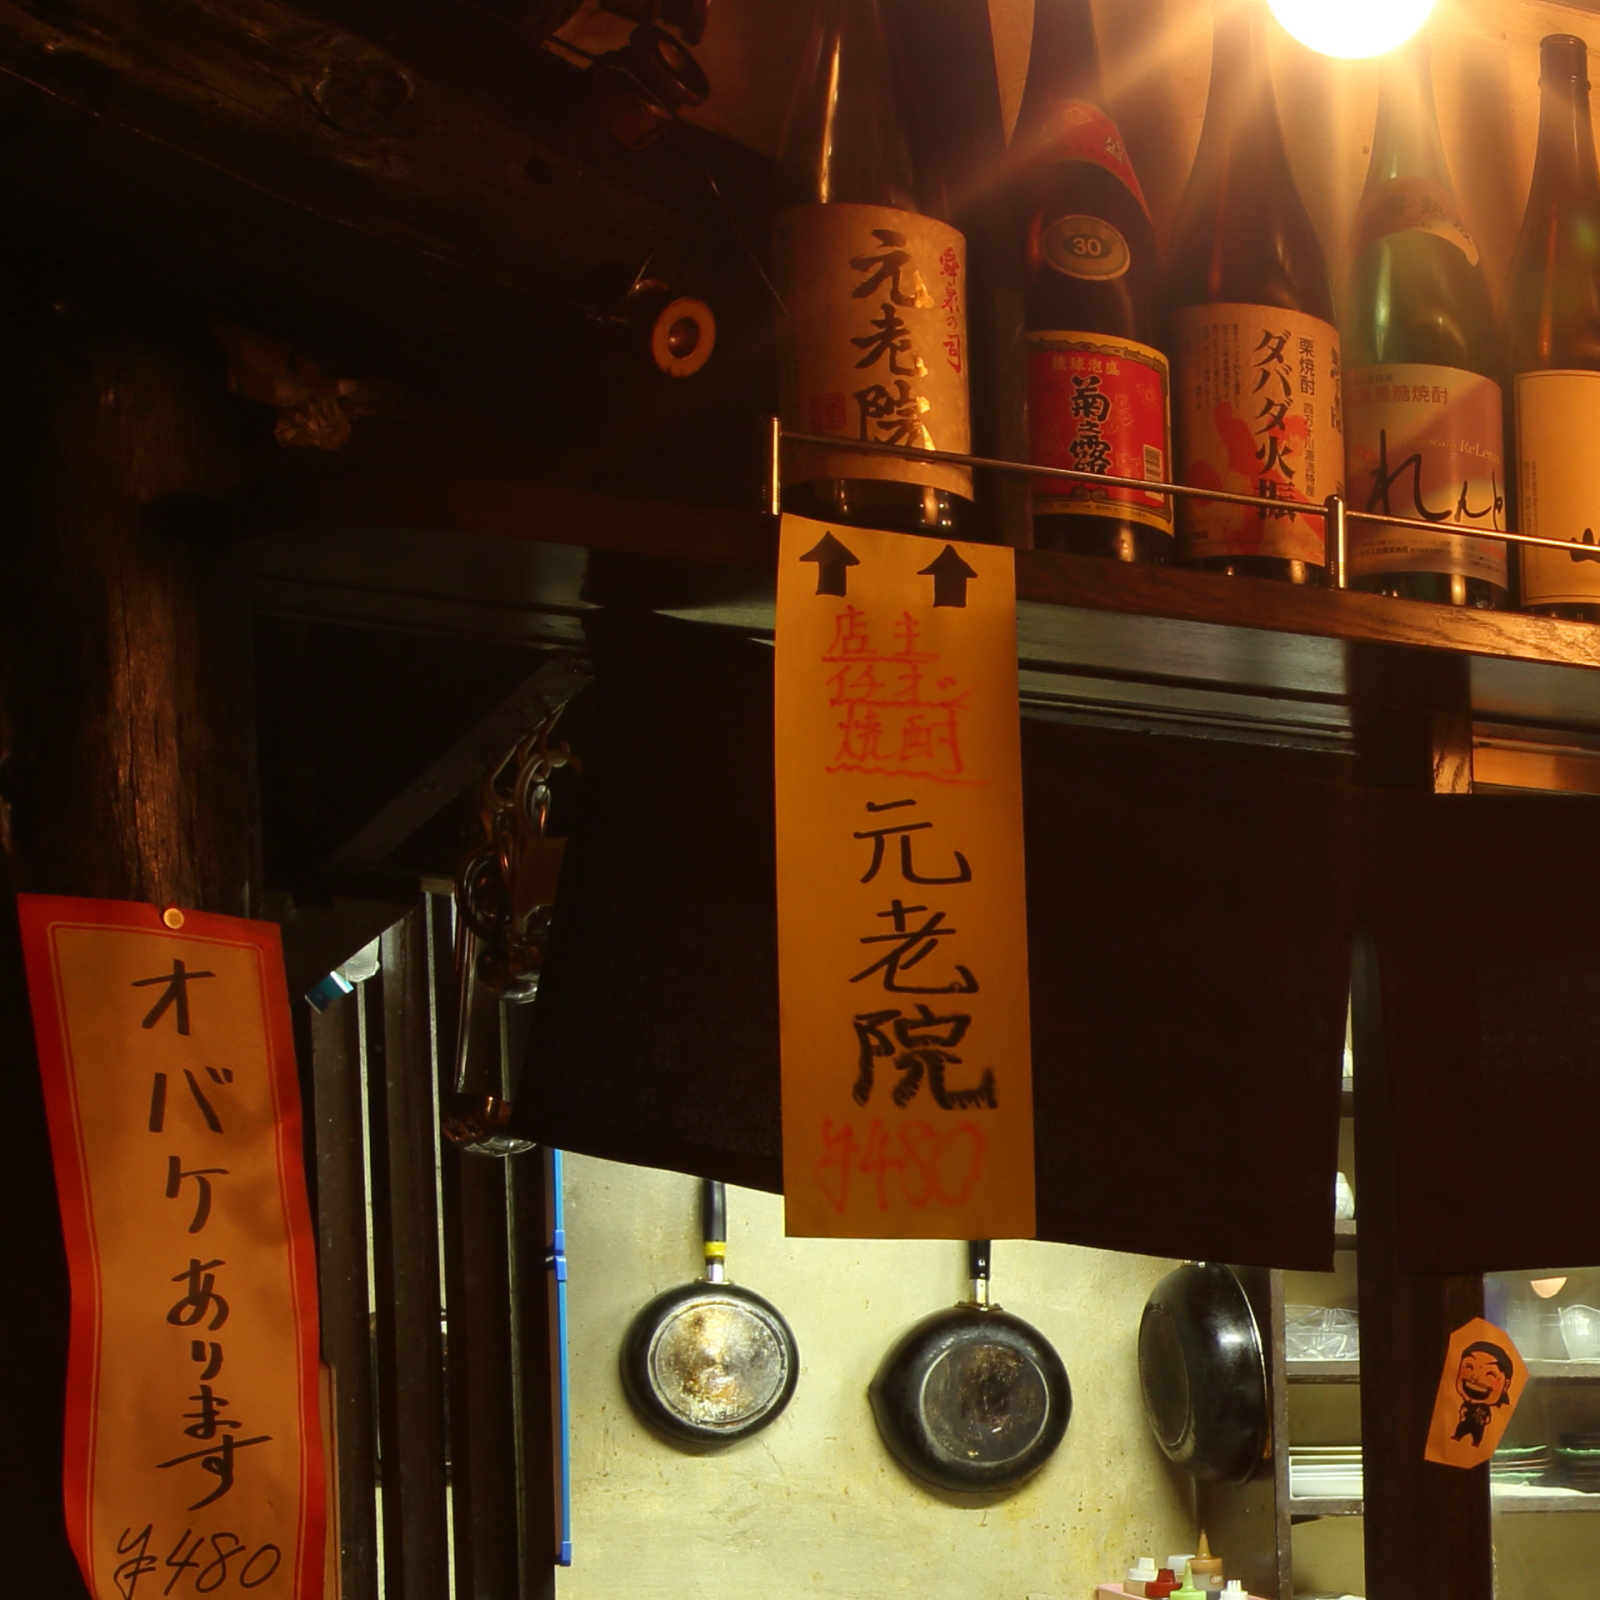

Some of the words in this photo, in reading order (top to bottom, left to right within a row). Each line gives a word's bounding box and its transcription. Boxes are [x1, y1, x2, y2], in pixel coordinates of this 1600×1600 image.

[1072, 237, 1102, 256] 30
[1052, 355, 1120, 377] 琉球泡盛
[1298, 337, 1315, 396] 栗焼酎
[1069, 374, 1114, 476] 菊之露
[1252, 329, 1297, 522] ダバダ火振
[828, 604, 920, 656] 店主
[834, 702, 965, 775] 焼酎
[848, 799, 998, 1112] 元老院
[130, 958, 273, 1512] オバケあります
